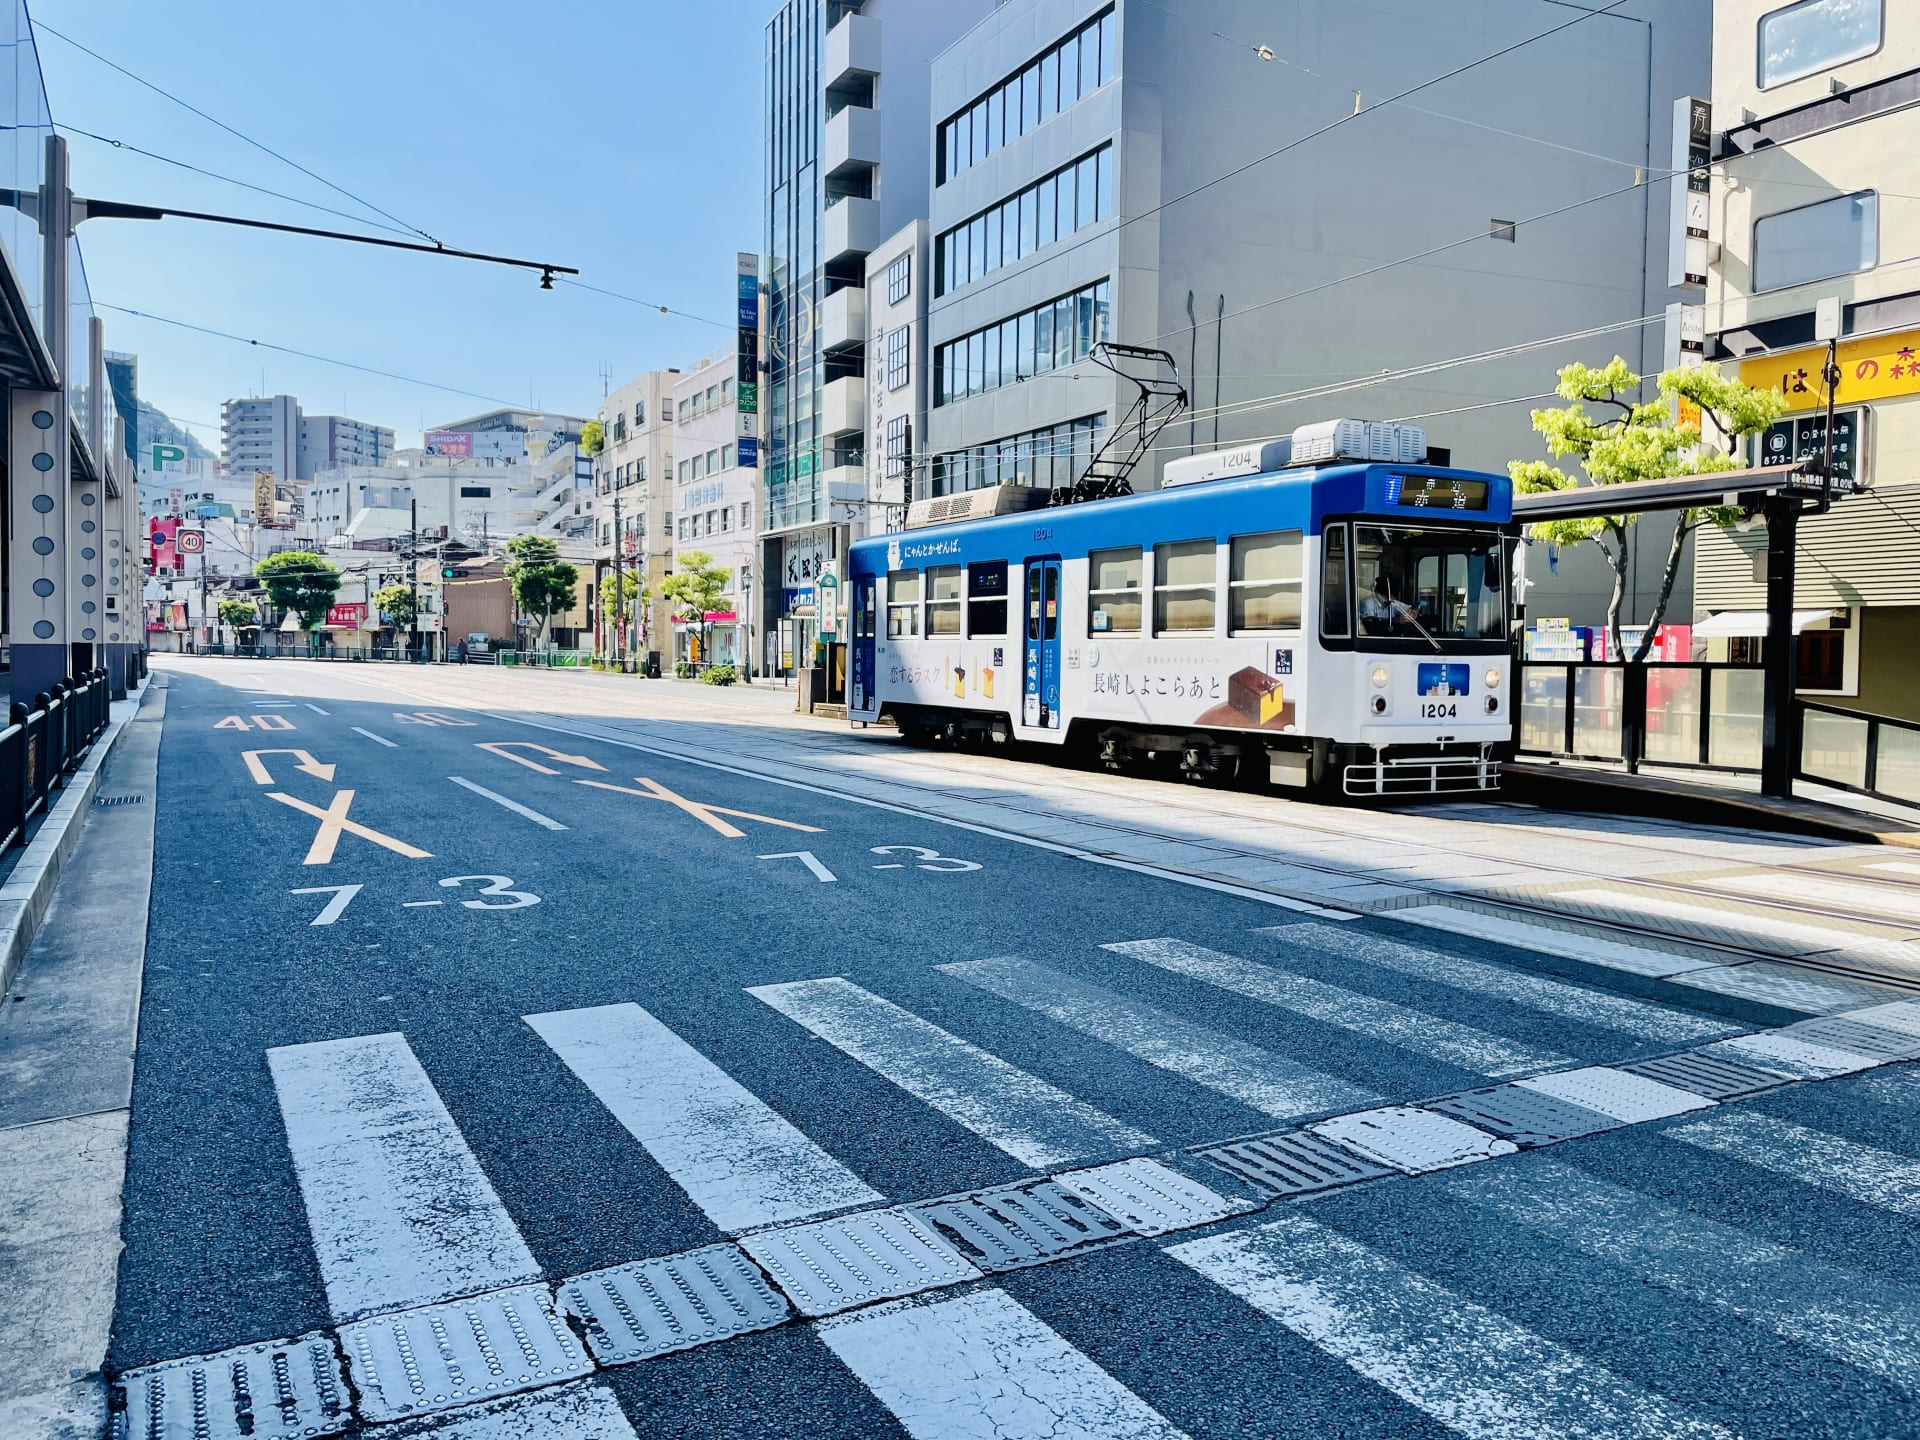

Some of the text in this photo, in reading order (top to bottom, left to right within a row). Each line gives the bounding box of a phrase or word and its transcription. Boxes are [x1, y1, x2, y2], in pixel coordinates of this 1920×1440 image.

[1693, 105, 1707, 132] 寿
[1693, 181, 1703, 192] 7F
[429, 435, 467, 443] SHIDAX
[153, 445, 185, 471] P
[1223, 451, 1251, 468] 1204
[1033, 527, 1053, 541] 1204
[185, 537, 198, 547] 40
[889, 664, 940, 684] 恋するラスク
[1093, 672, 1220, 699] 長崎しよこらあと
[1421, 704, 1457, 719] 1204
[213, 715, 298, 731] 40
[392, 712, 479, 727] 40
